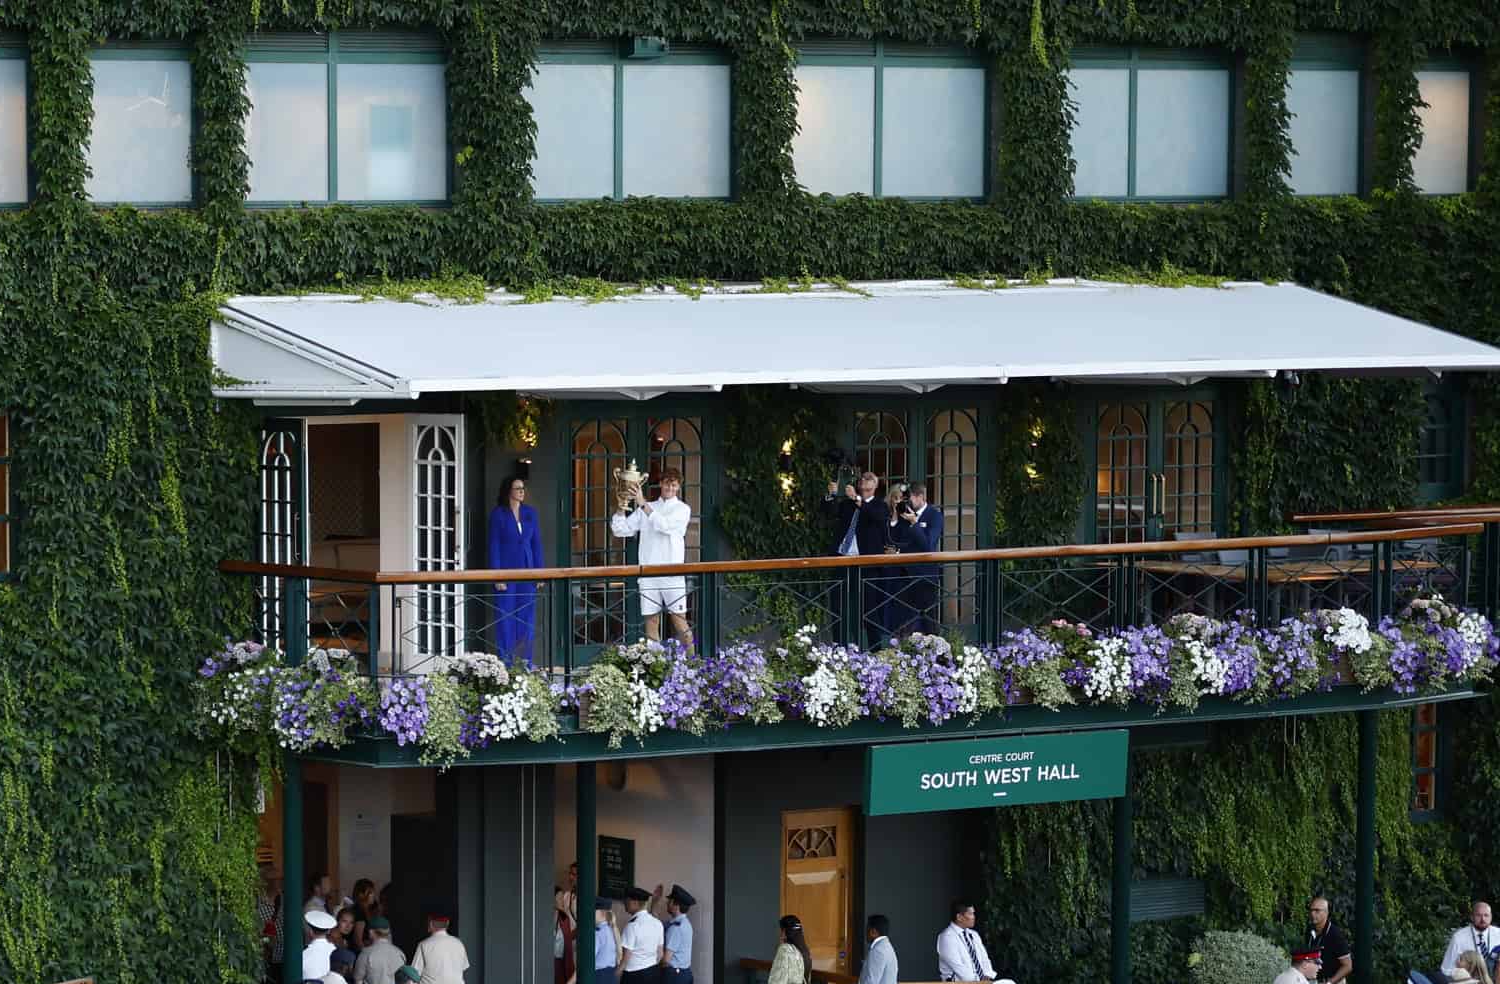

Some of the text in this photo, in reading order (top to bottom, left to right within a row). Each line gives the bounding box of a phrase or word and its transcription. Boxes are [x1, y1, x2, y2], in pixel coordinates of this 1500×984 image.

[969, 752, 1034, 764] CENTRE COURT
[920, 764, 1079, 790] SOUTH WEST HALL
